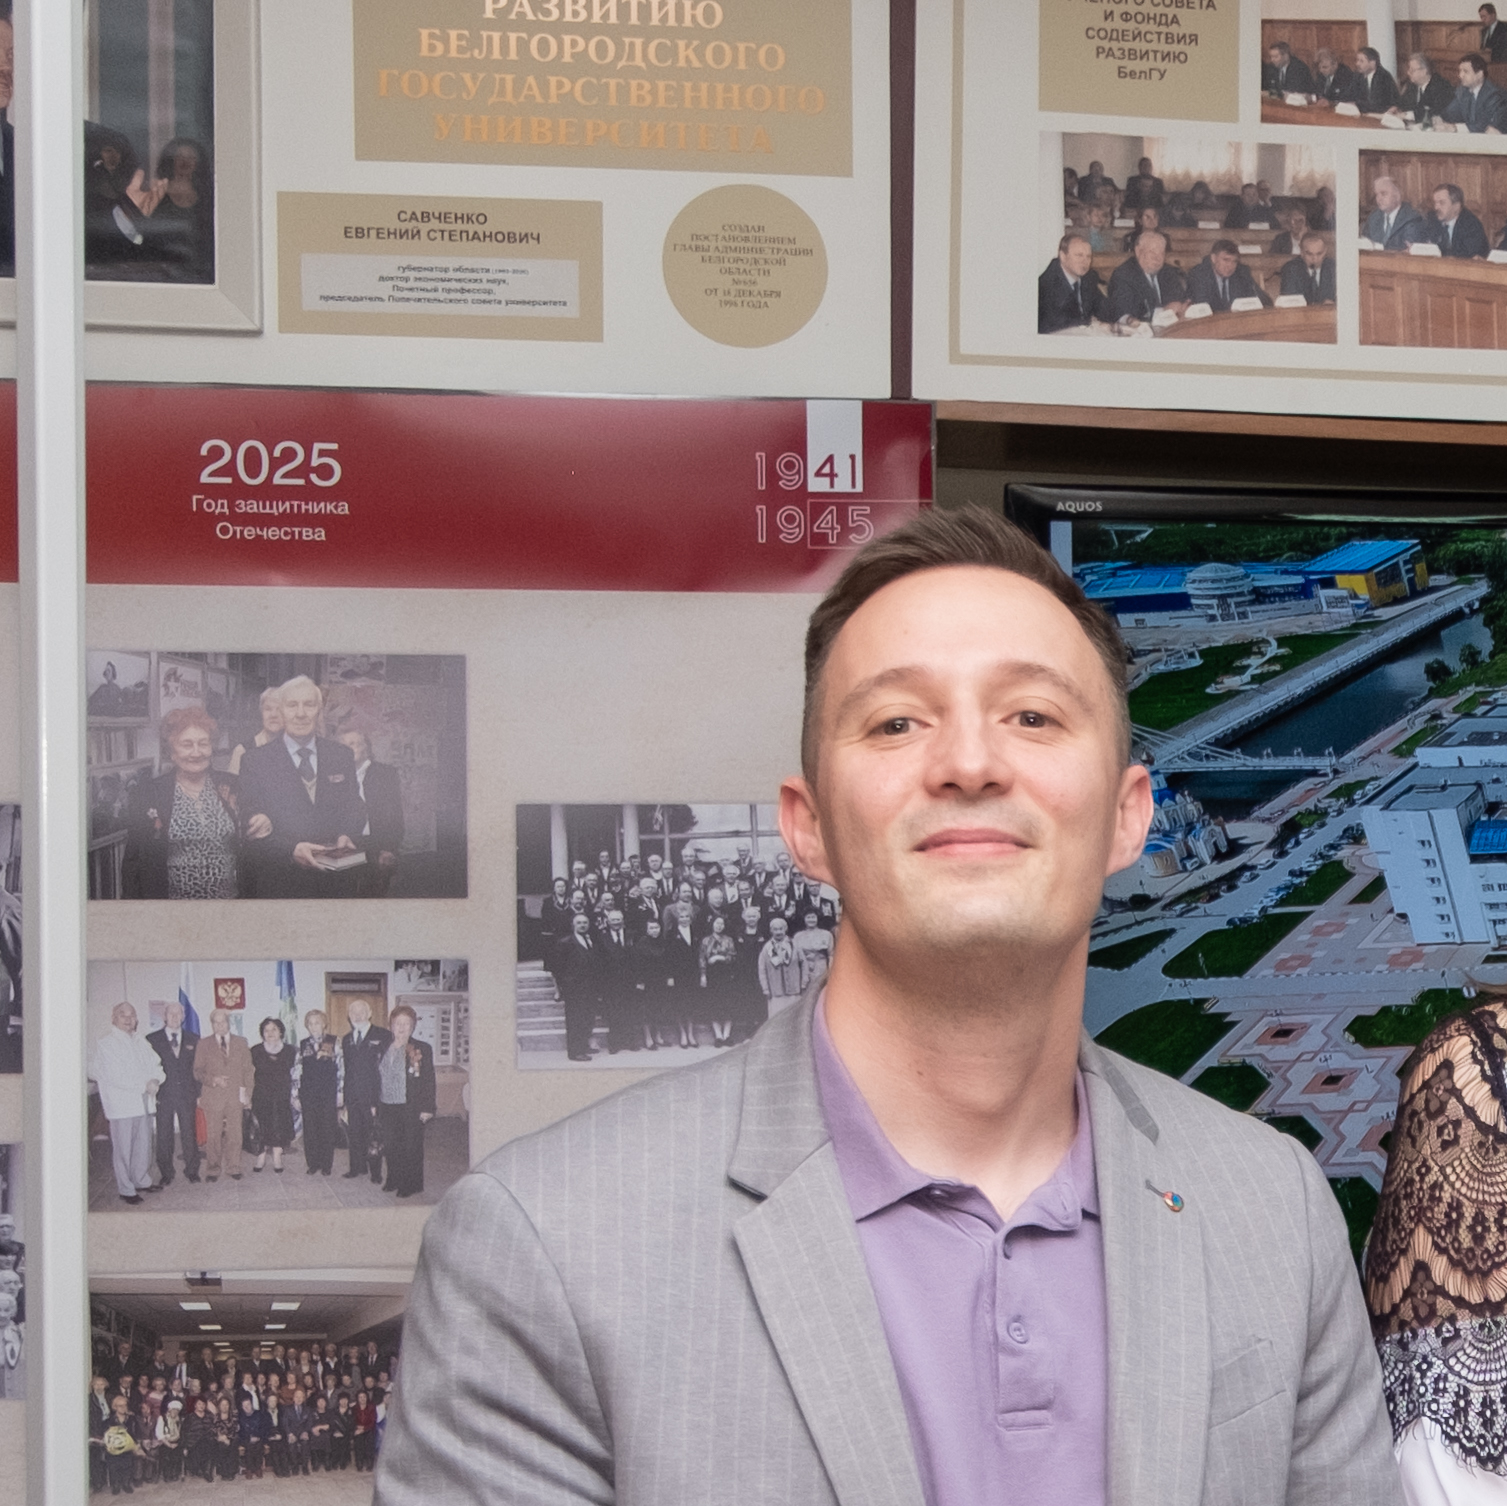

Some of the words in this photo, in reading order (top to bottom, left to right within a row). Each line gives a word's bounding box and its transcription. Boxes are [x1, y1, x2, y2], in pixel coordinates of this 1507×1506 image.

[483, 0, 723, 29] РАЗВИТИЮ
[1103, 10, 1114, 22] И
[1120, 11, 1181, 28] ФОНДА
[1085, 27, 1198, 46] СОДЕЙСТВИЯ
[418, 28, 787, 73] БЕЛГОРОДСКОГО
[1095, 46, 1188, 64] РАЗВИТИЮ
[1117, 66, 1167, 81] БелГУ
[377, 68, 827, 117] ГОСУДАРСТВЕННОГО
[431, 112, 776, 155] УНИВЕРСИТЕТА
[397, 210, 488, 226] САВЧЕНКО
[343, 225, 422, 241] ЕВГЕНИЙ
[427, 228, 541, 245] СТЕПАНОВИЧ
[719, 267, 771, 278] ОБЛАСТИ
[704, 288, 719, 297] ОТ
[740, 300, 769, 309] ГОДА
[200, 439, 343, 487] 2025
[755, 452, 857, 490] 1941
[192, 494, 230, 521] Год
[234, 496, 350, 521] защитника
[1056, 501, 1103, 514] AQUOS
[215, 520, 326, 542] Отечества
[755, 505, 874, 544] 1945
